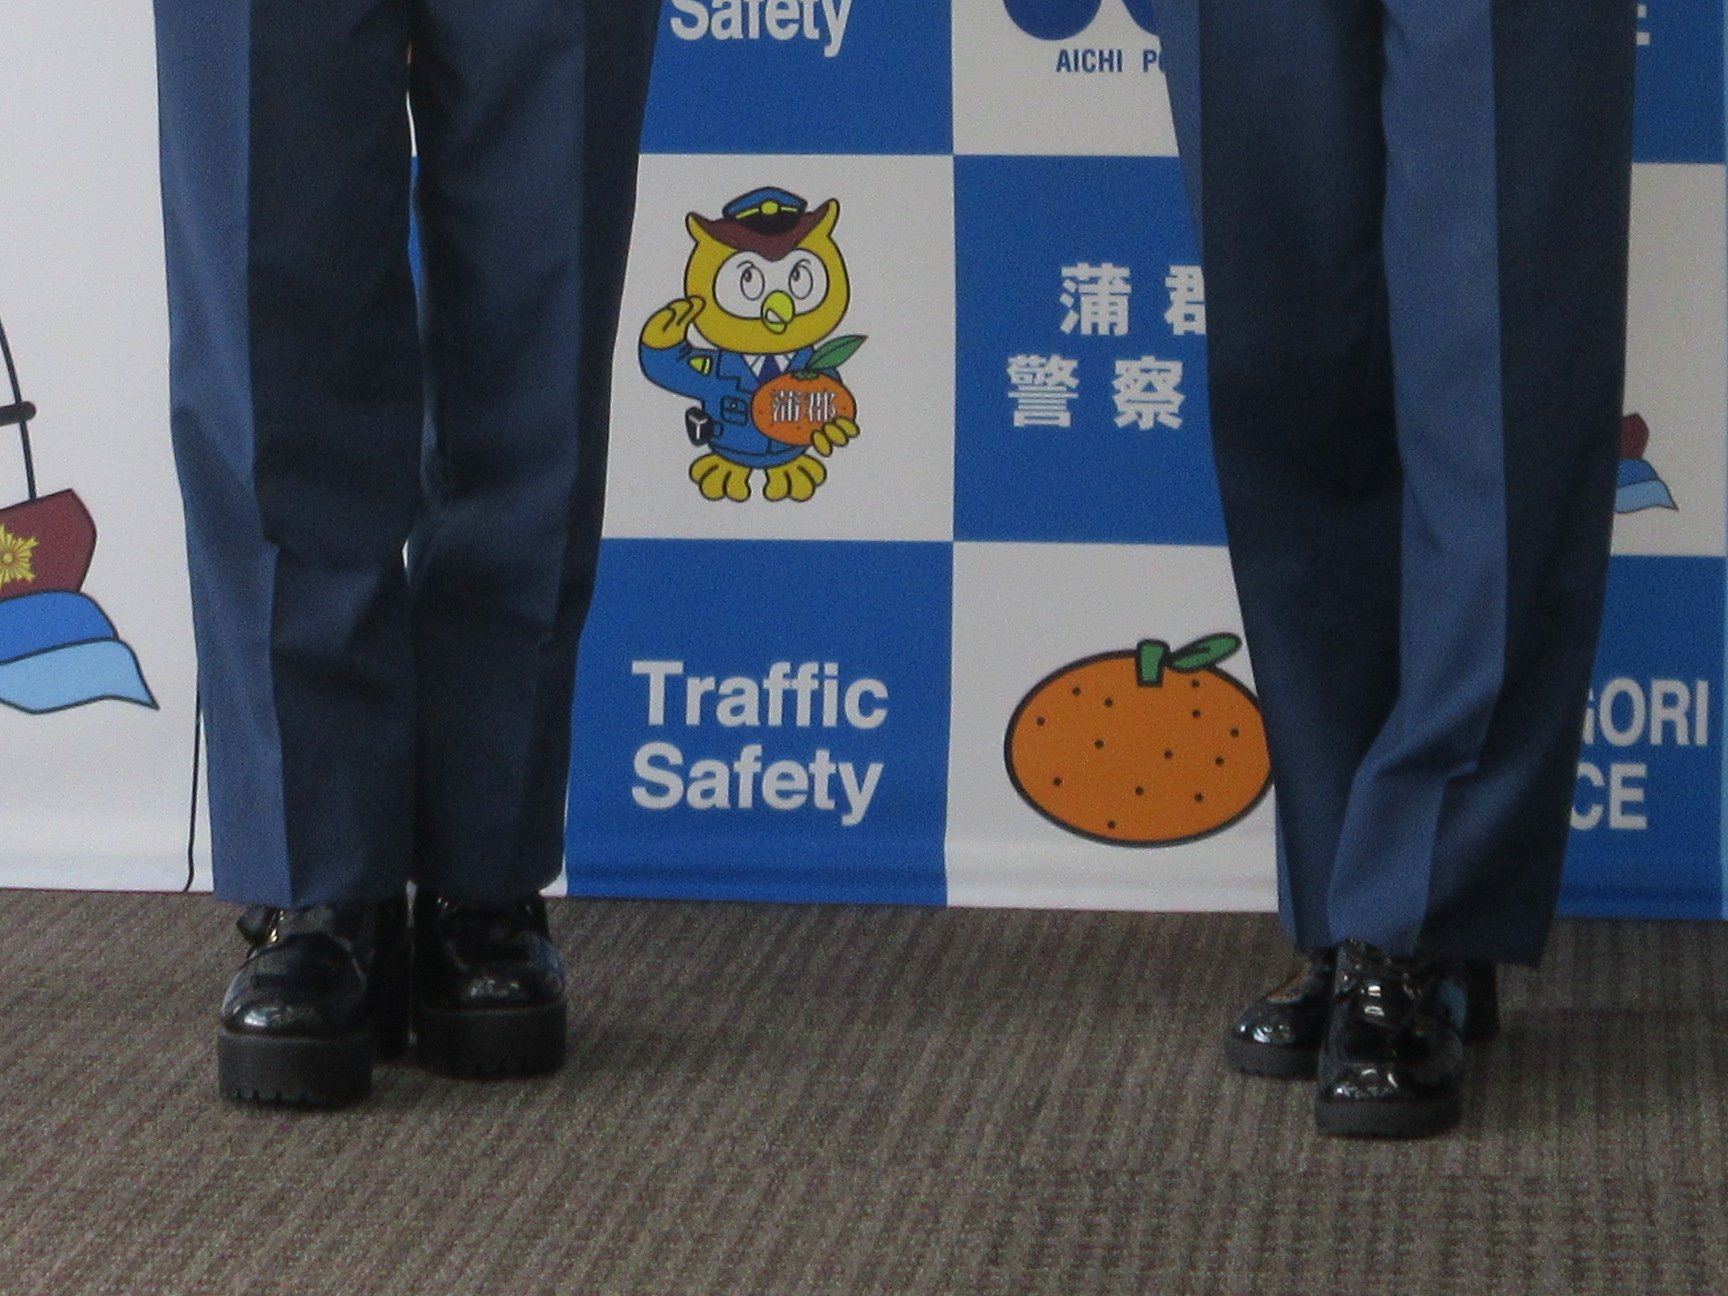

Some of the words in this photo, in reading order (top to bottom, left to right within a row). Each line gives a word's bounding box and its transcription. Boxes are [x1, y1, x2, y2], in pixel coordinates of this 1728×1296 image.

[1056, 49, 1123, 73] AICHI
[632, 660, 889, 730] Traffic
[631, 741, 884, 827] Safety
